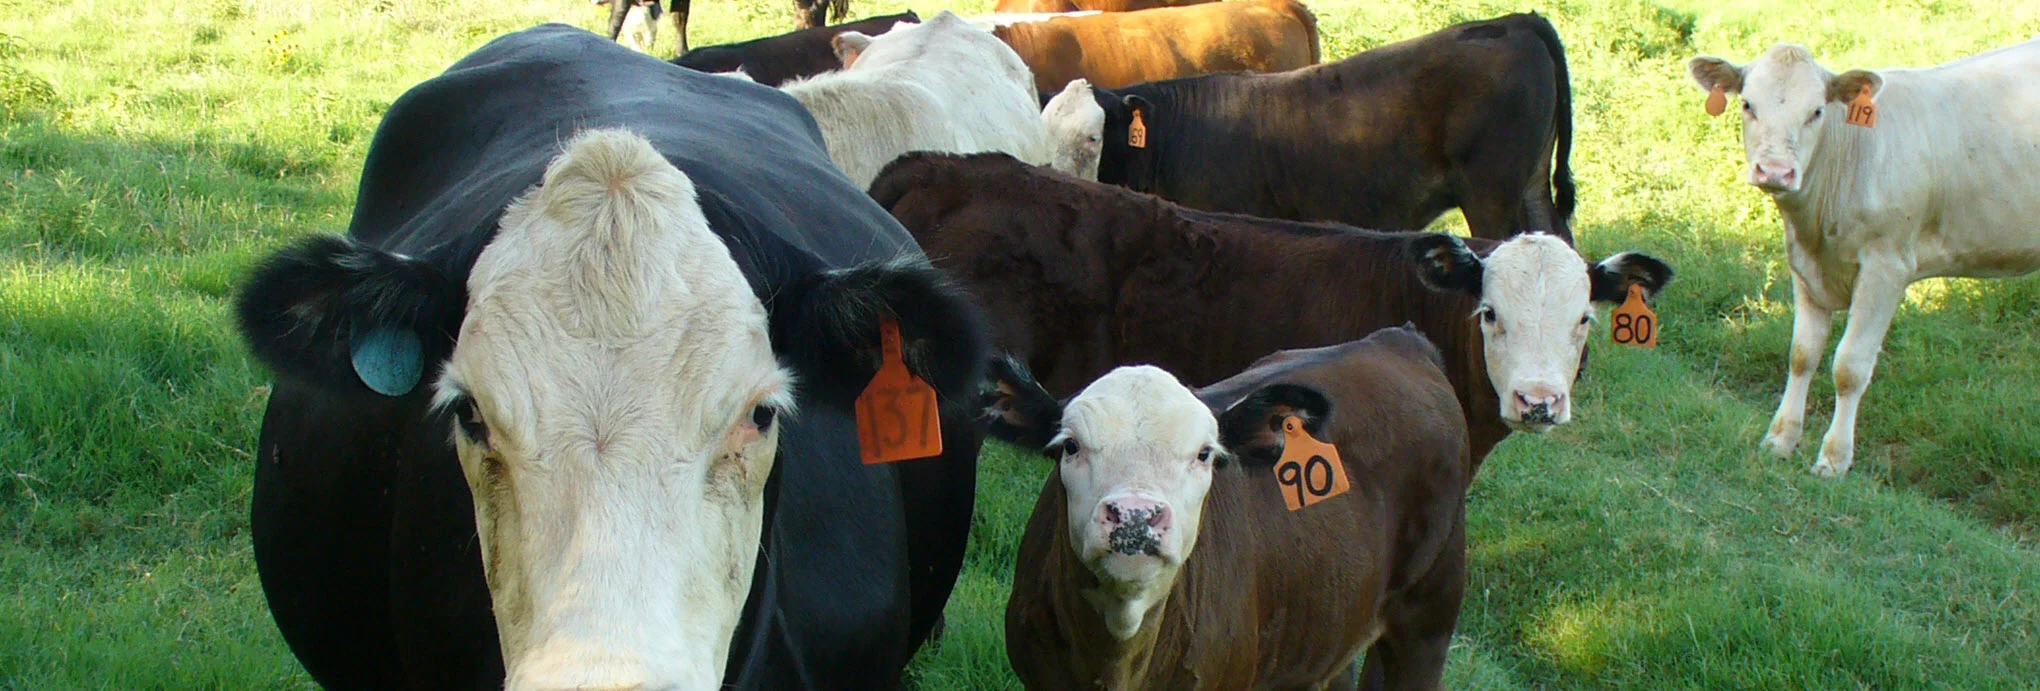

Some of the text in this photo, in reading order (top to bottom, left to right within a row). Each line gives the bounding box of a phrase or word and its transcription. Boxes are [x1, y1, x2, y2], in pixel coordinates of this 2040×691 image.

[1848, 103, 1873, 124] 119
[1614, 313, 1651, 344] 80
[866, 384, 931, 457] 137
[1278, 454, 1333, 507] 90
